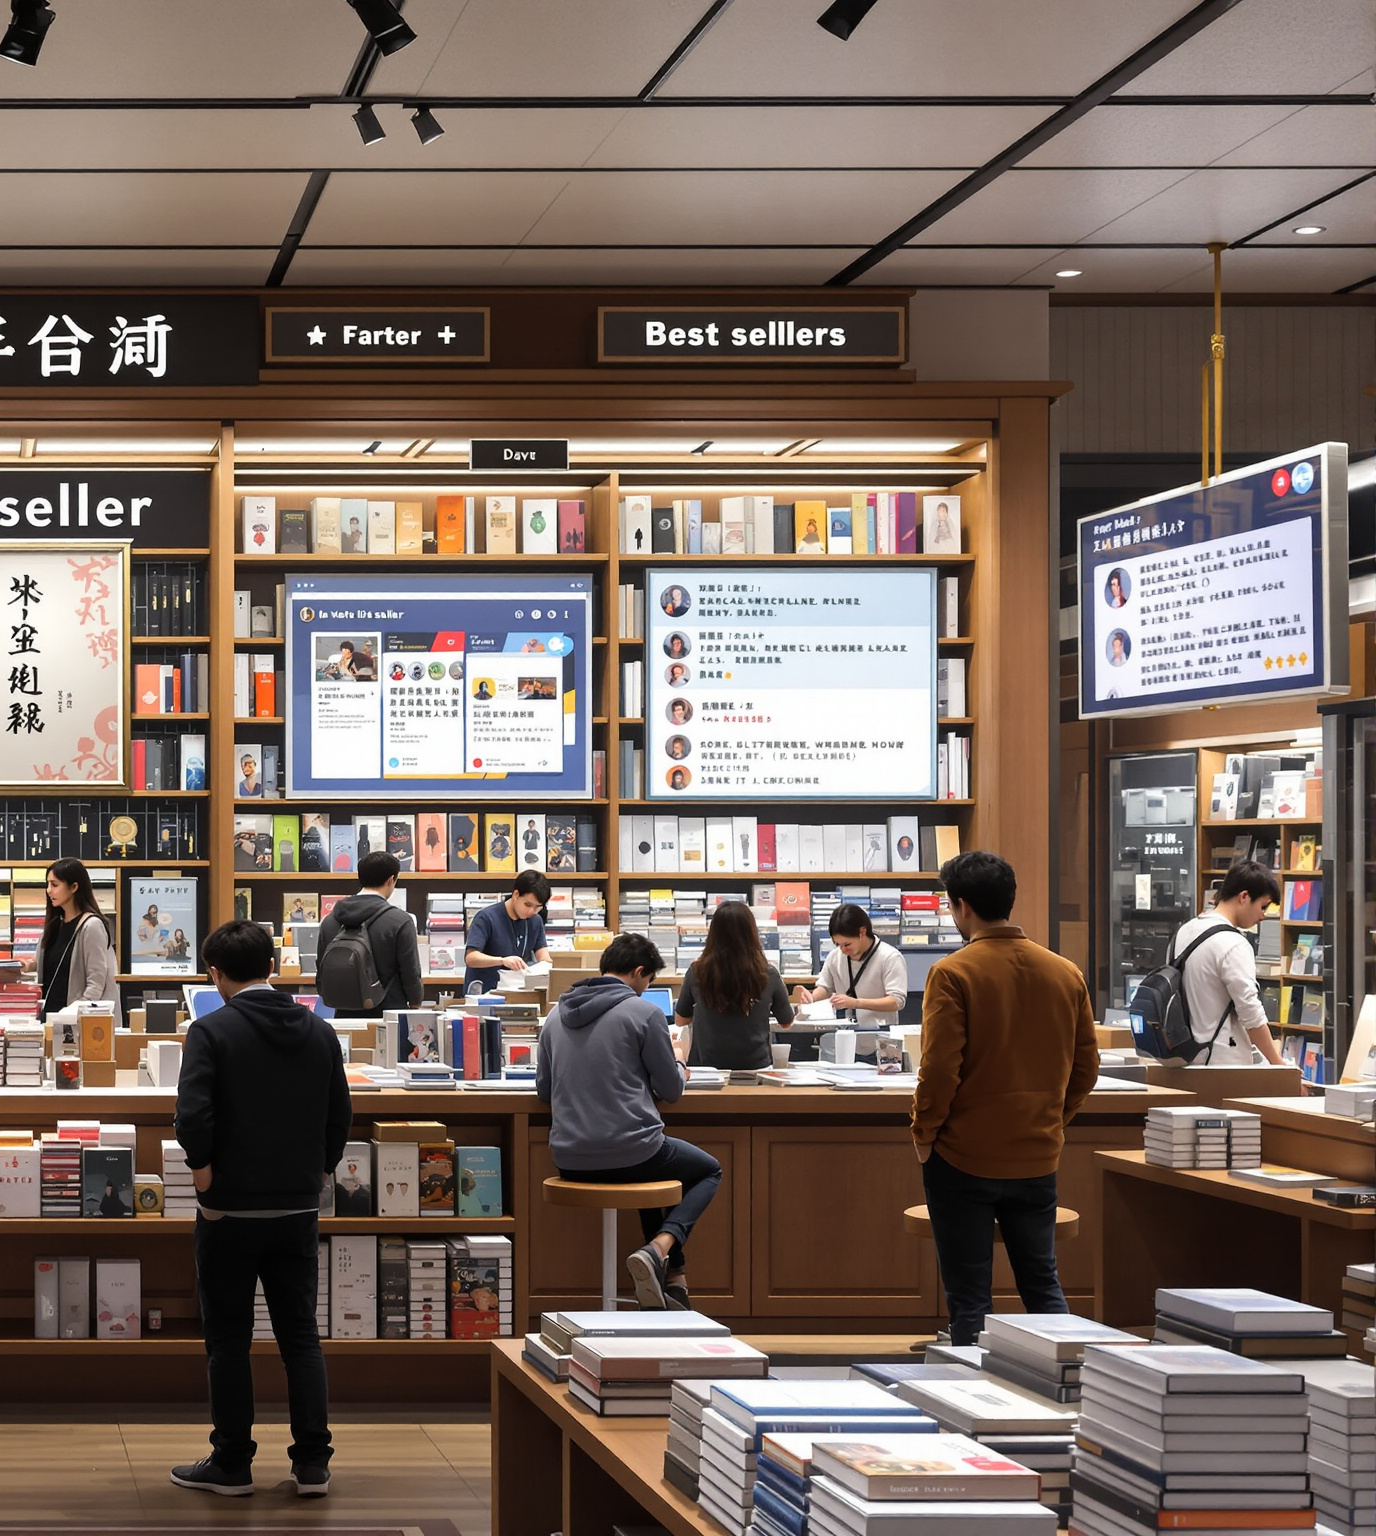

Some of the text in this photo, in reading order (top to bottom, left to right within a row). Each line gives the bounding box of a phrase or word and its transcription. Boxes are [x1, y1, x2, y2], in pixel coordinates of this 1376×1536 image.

[342, 325, 422, 346] Farter
[645, 320, 847, 347] Best selllers
